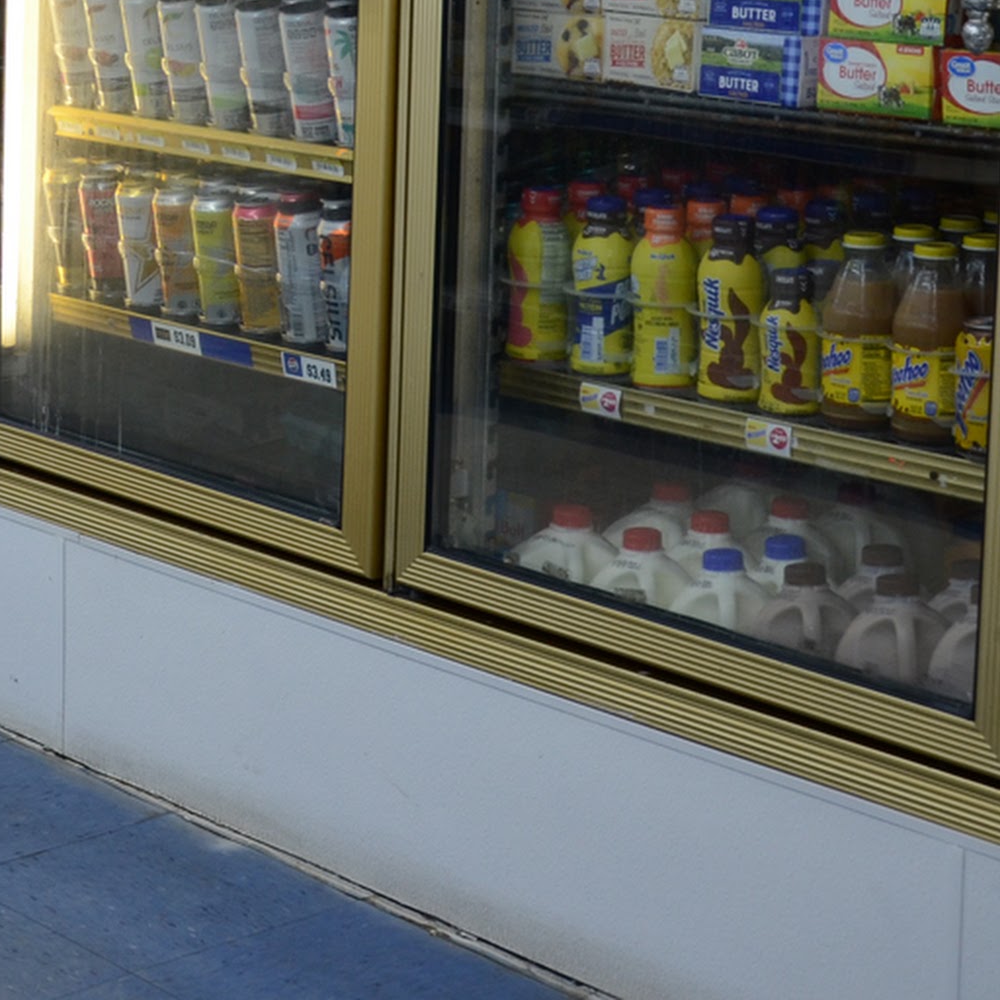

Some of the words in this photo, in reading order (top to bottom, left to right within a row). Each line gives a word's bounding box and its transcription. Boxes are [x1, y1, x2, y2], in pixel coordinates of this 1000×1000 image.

[731, 5, 777, 22] BUTTER
[610, 44, 646, 60] BUTTER
[839, 65, 877, 81] Butter
[718, 75, 759, 93] BUTTER
[703, 278, 725, 350] Nesquik
[766, 316, 784, 373] Nesquik
[306, 363, 331, 383] $3.49
